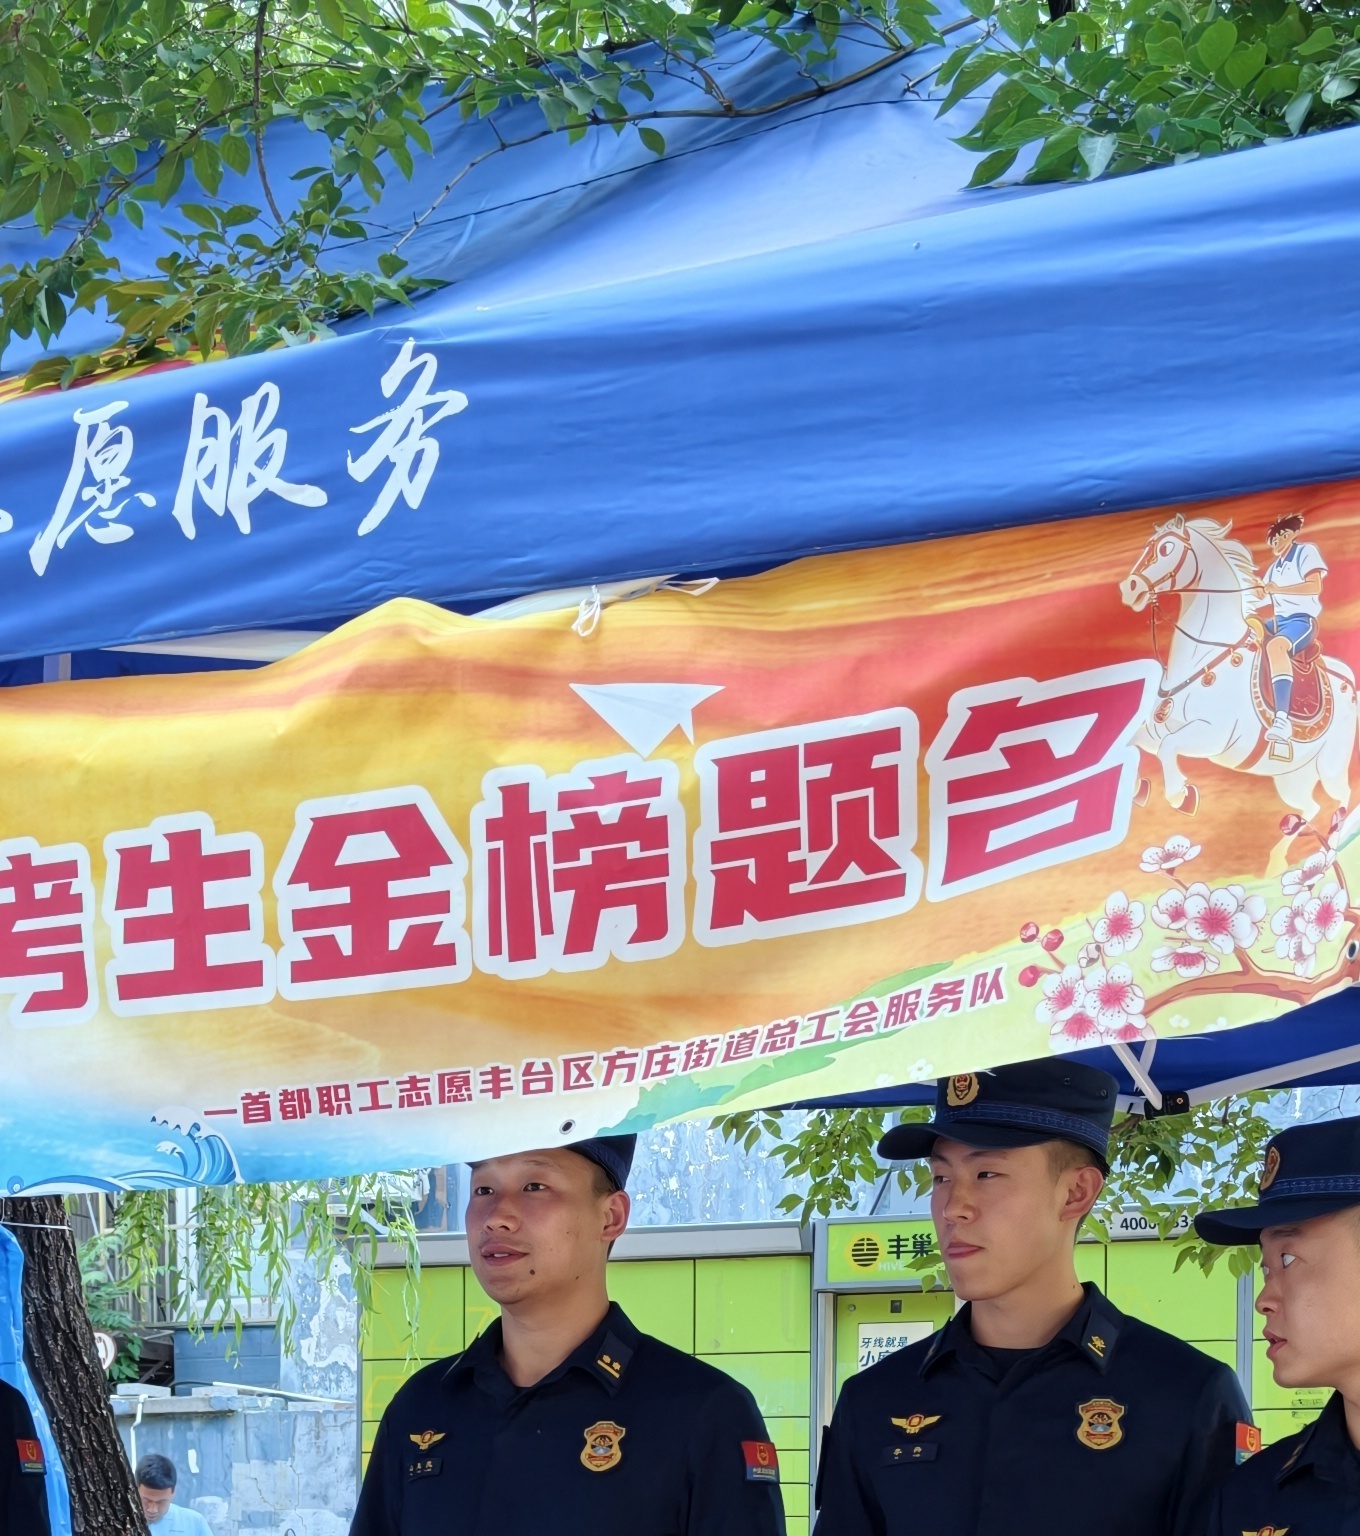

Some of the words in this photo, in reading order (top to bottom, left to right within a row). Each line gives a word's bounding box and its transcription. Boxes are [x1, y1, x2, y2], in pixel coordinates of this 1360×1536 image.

[887, 1233, 934, 1260] 丰巢
[859, 1336, 908, 1348] 牙线就是
